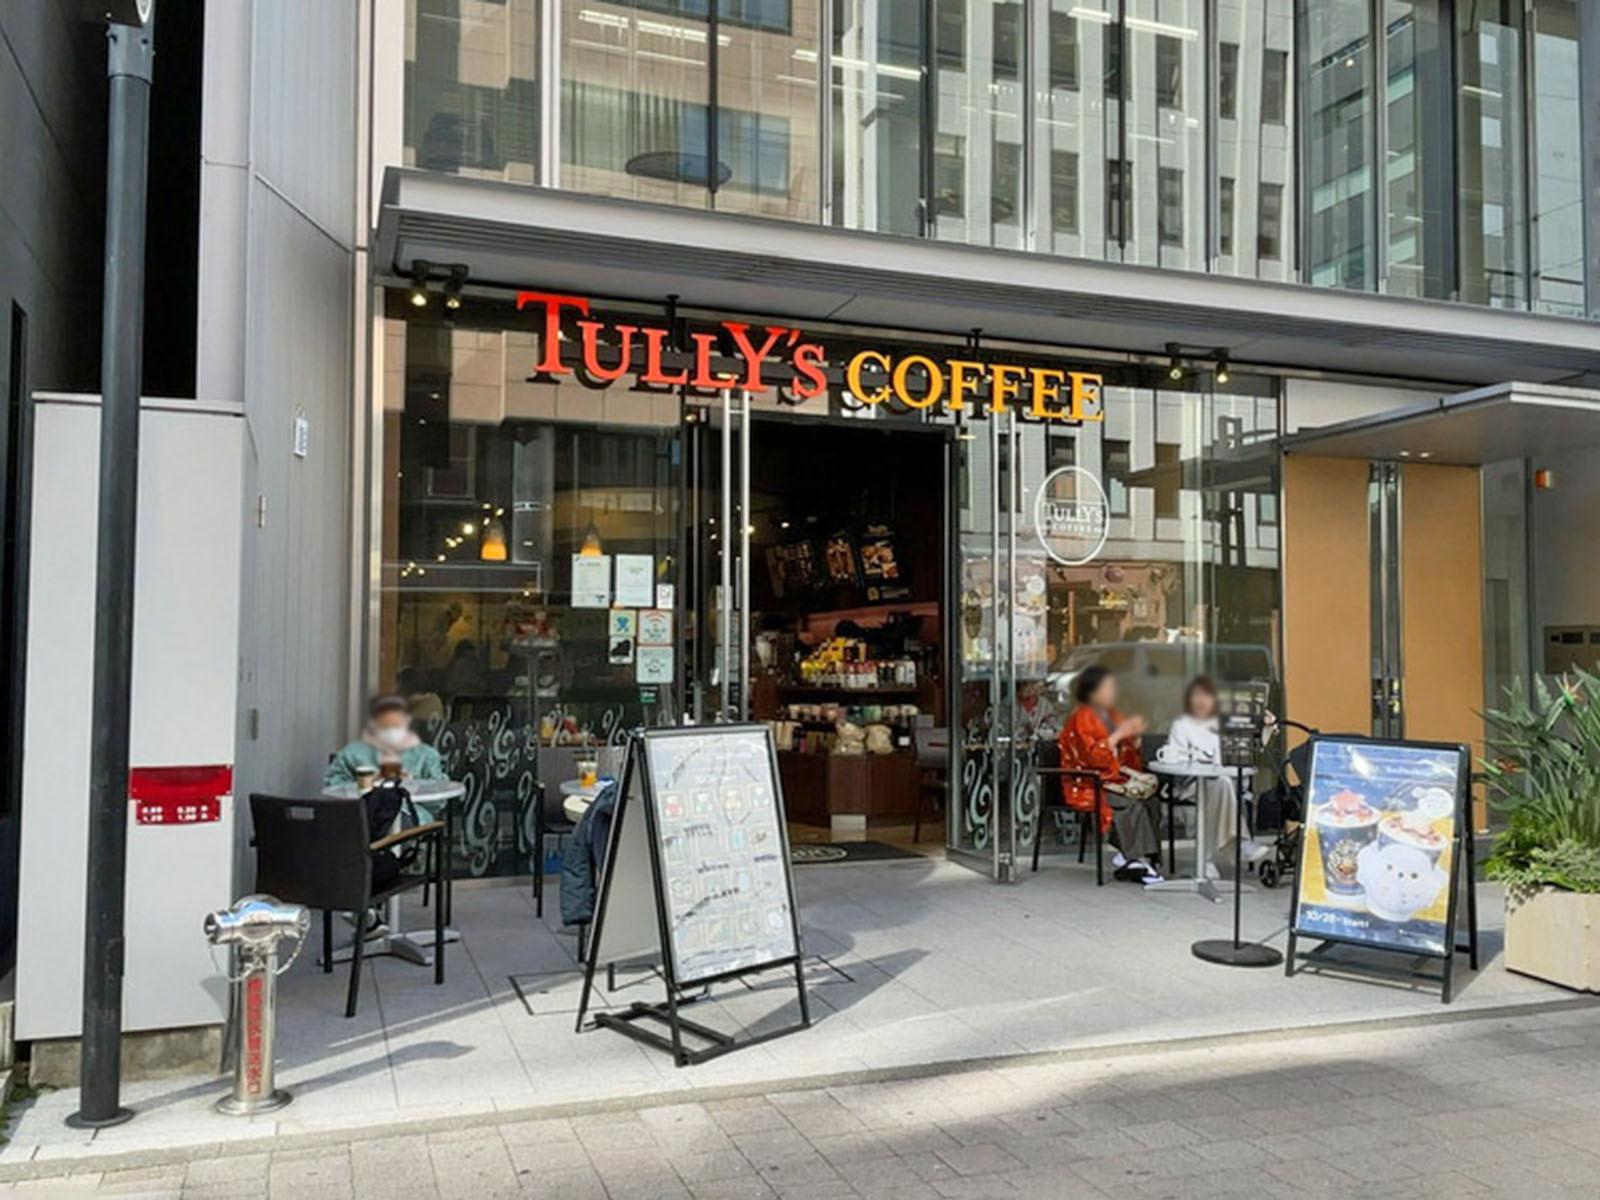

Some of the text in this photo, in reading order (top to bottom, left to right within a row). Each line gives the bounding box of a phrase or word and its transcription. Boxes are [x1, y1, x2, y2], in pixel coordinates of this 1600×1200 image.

[517, 291, 1105, 421] TULLY'S COFFEE
[1042, 503, 1103, 524] TULLY'S
